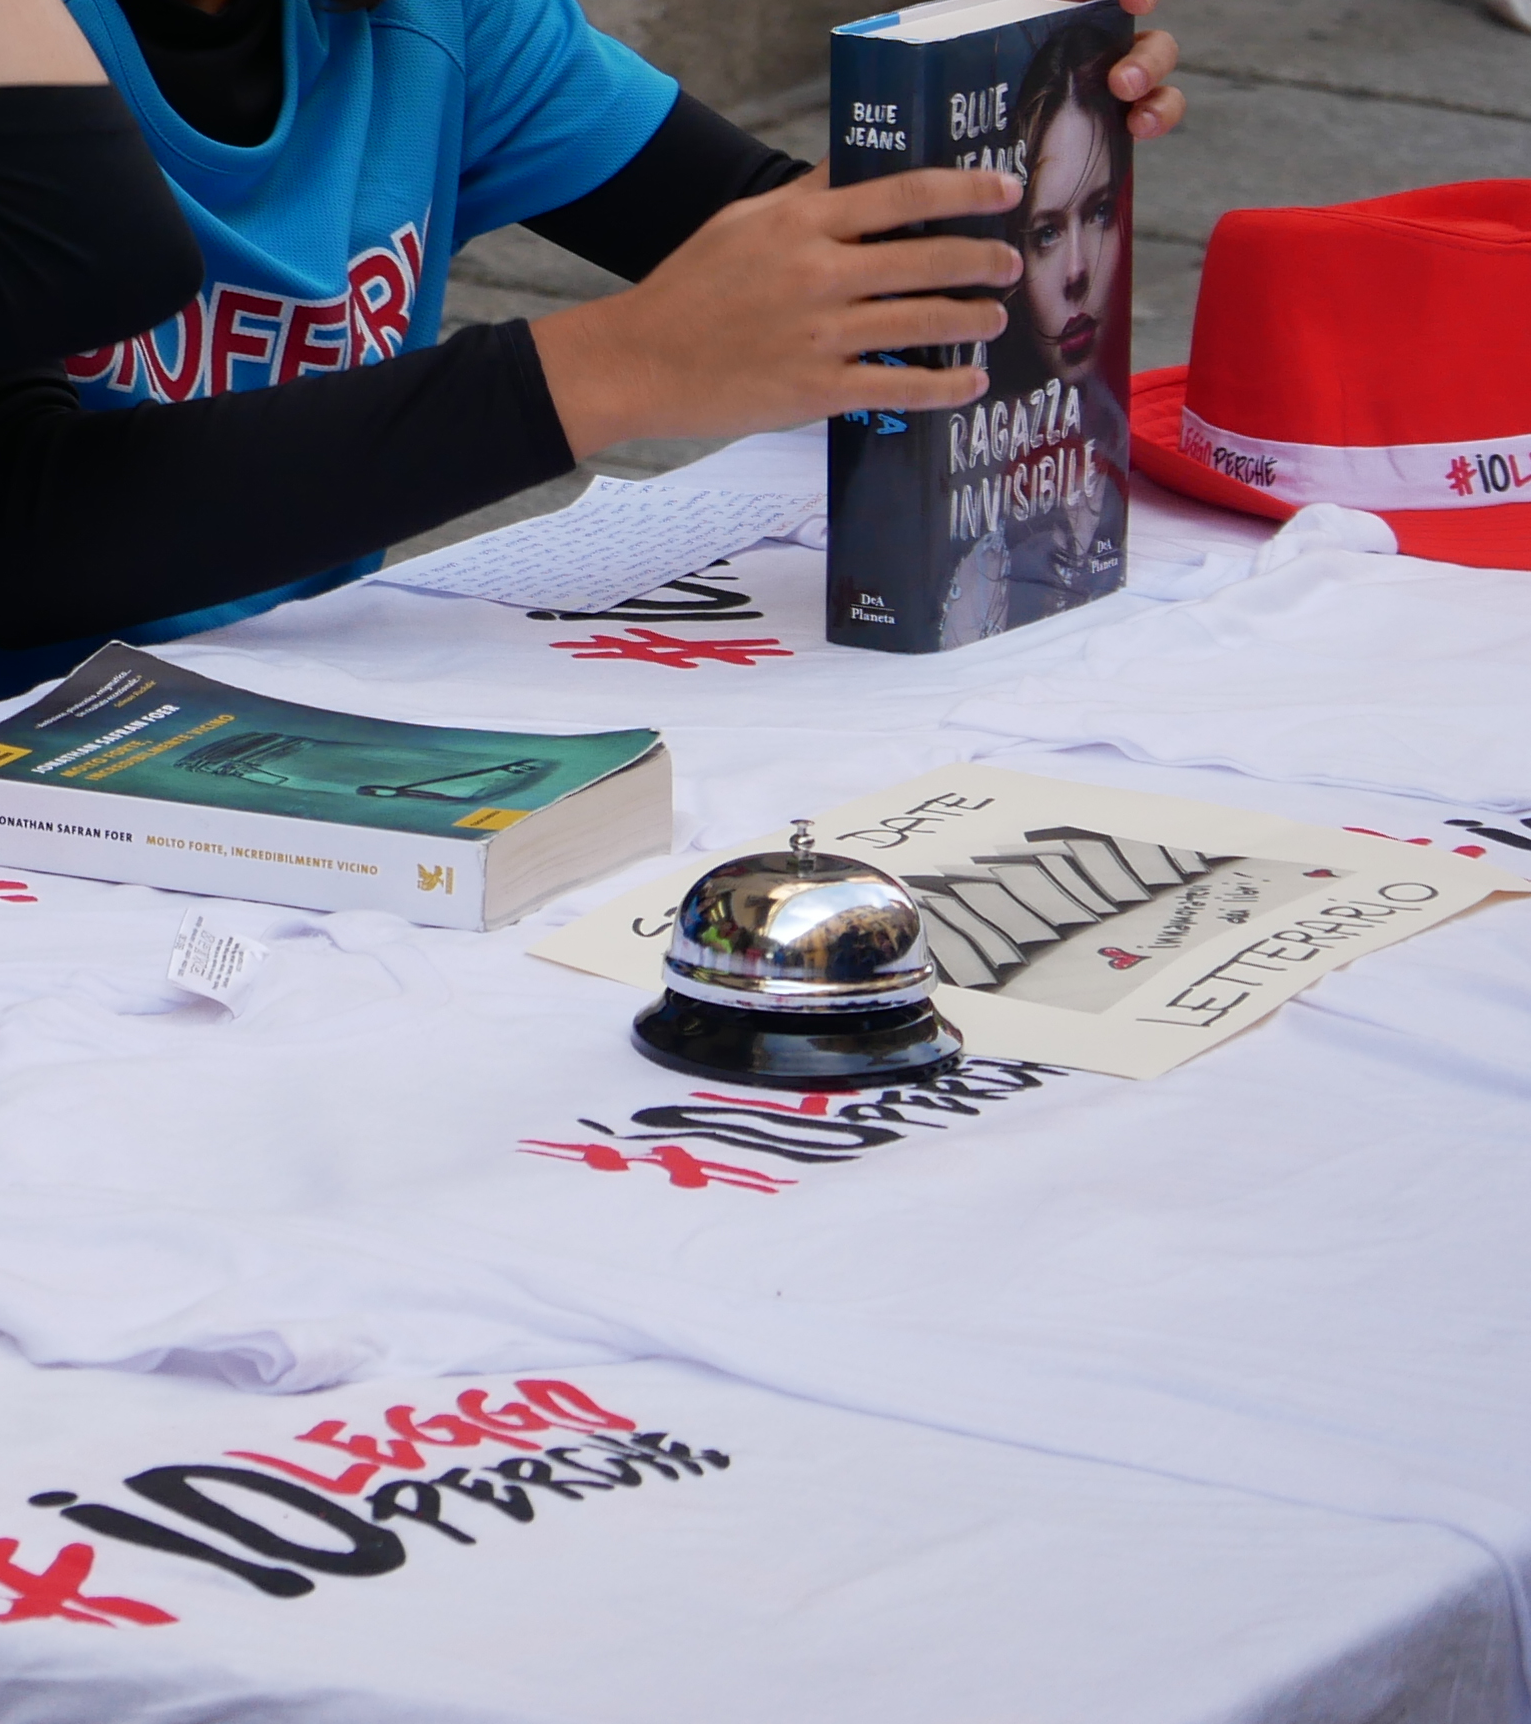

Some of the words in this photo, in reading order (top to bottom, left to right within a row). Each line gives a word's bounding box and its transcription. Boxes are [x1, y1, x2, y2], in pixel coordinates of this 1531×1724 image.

[845, 127, 907, 151] JEANS
[853, 102, 898, 124] BLUE
[950, 82, 1009, 142] BLUE
[949, 378, 1081, 475] RAGAZZA
[949, 439, 1097, 542] INVISIBILE
[1090, 556, 1119, 574] Planeta
[851, 607, 896, 625] Planeta
[861, 593, 885, 608] DeA
[31, 742, 103, 774] JONATHAN
[94, 717, 150, 746] SAFRAN
[143, 703, 181, 722] FOER
[835, 792, 996, 849] DATE
[57, 823, 101, 838] SAFRAN
[104, 830, 133, 843] FOER
[146, 834, 186, 850] MOLTO
[188, 841, 228, 857] FORTE,
[231, 847, 334, 870] INCREDIBILMENTE
[337, 860, 378, 876] VICINO
[1135, 882, 1439, 1028] LETTERARIO
[222, 1379, 637, 1495] LEGGO
